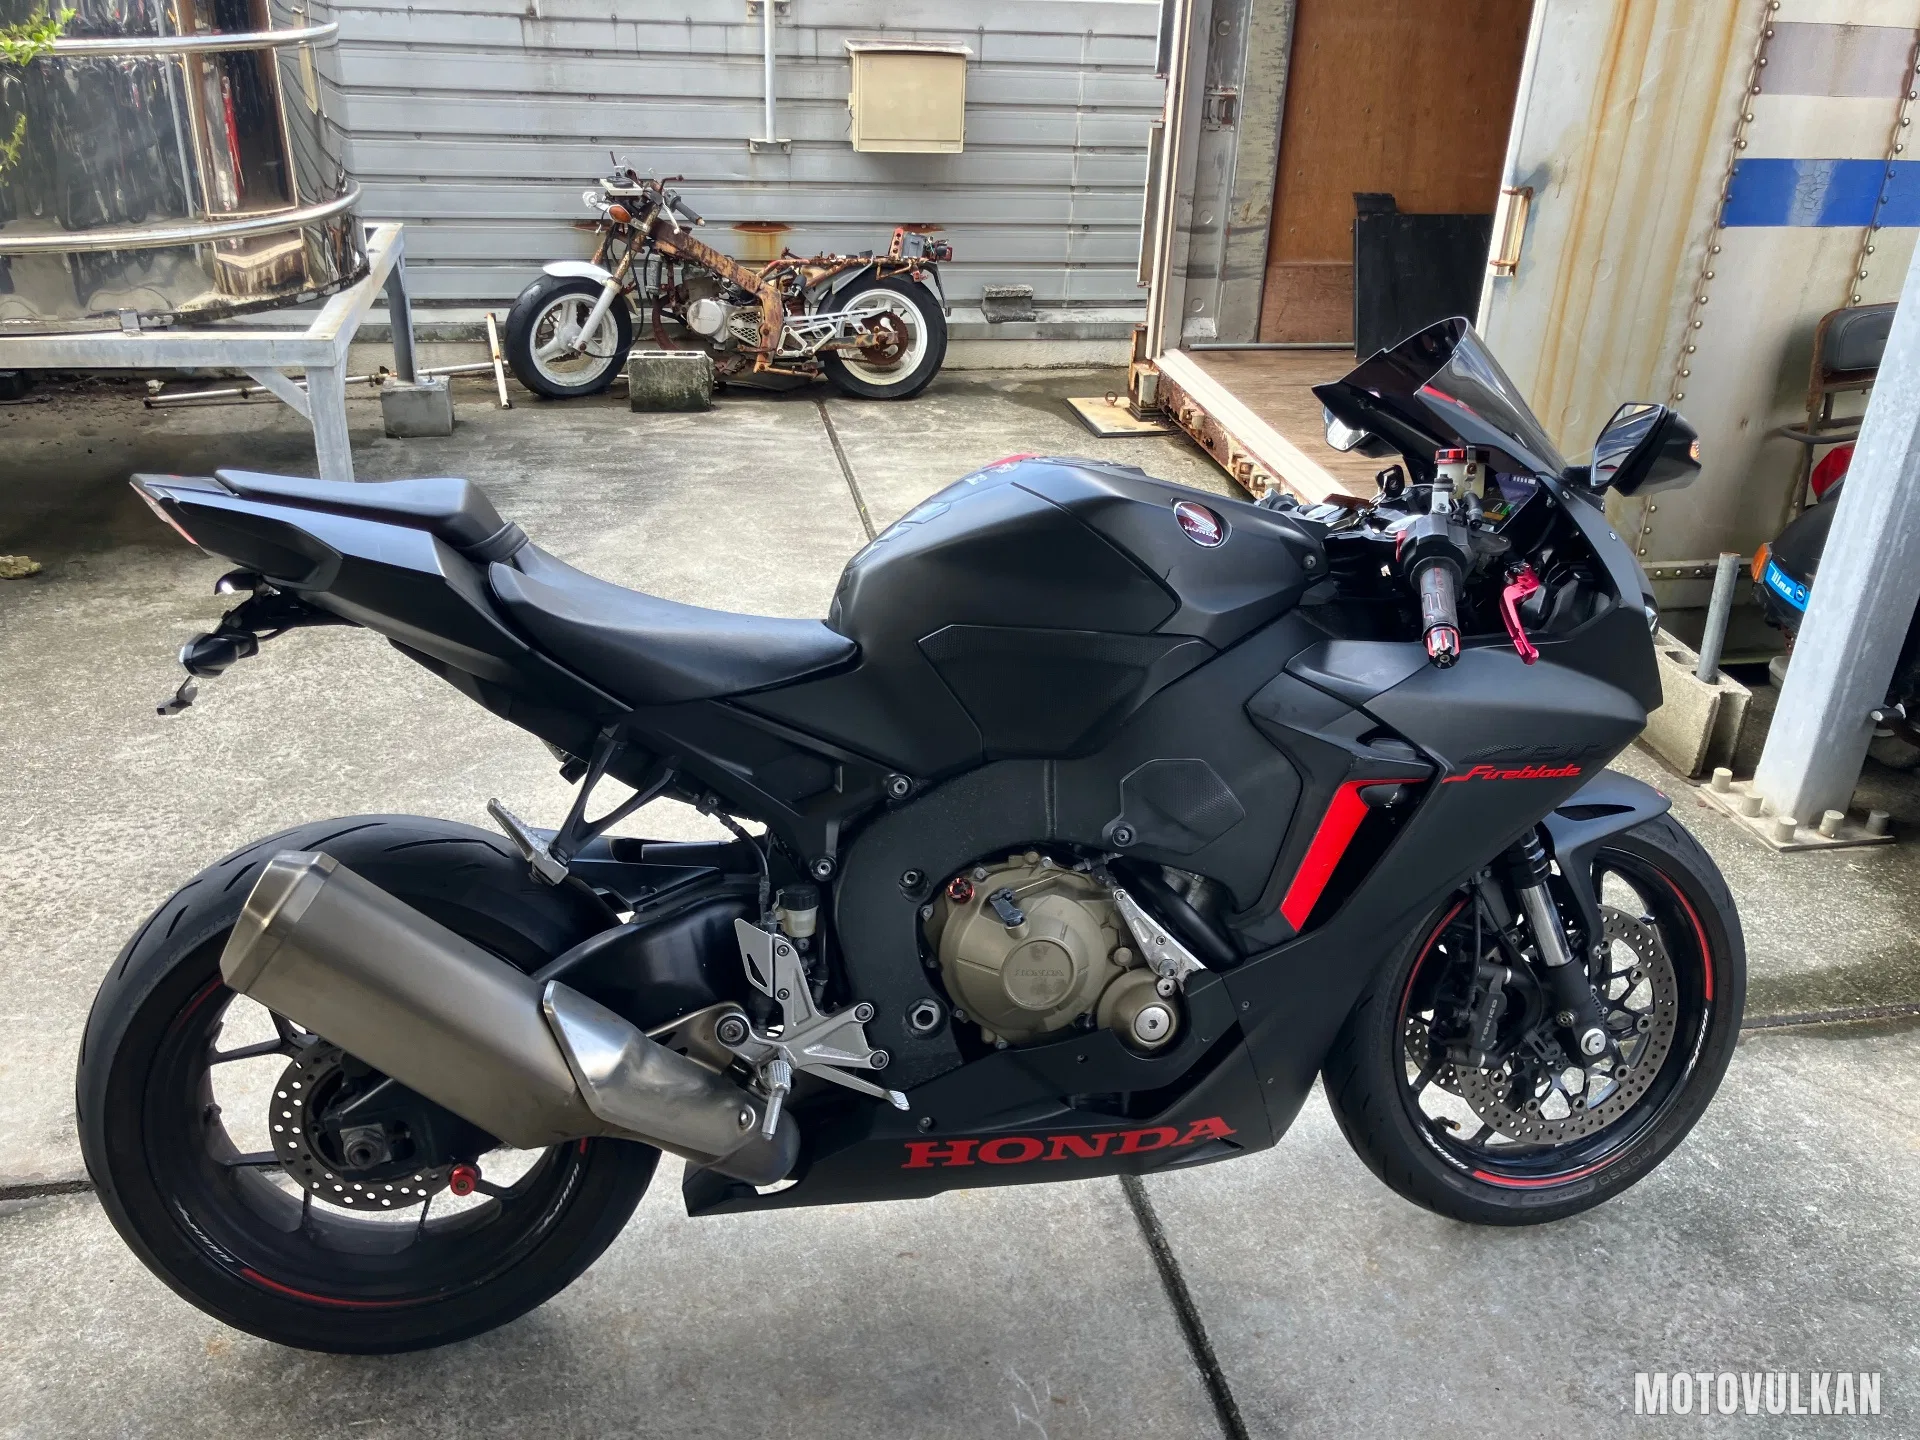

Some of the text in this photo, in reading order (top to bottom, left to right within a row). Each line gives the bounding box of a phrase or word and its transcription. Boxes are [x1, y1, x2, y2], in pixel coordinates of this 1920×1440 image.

[1442, 763, 1582, 784] Fireblade
[1480, 999, 1498, 1042] TOKICO
[901, 1115, 1237, 1169] HONDA
